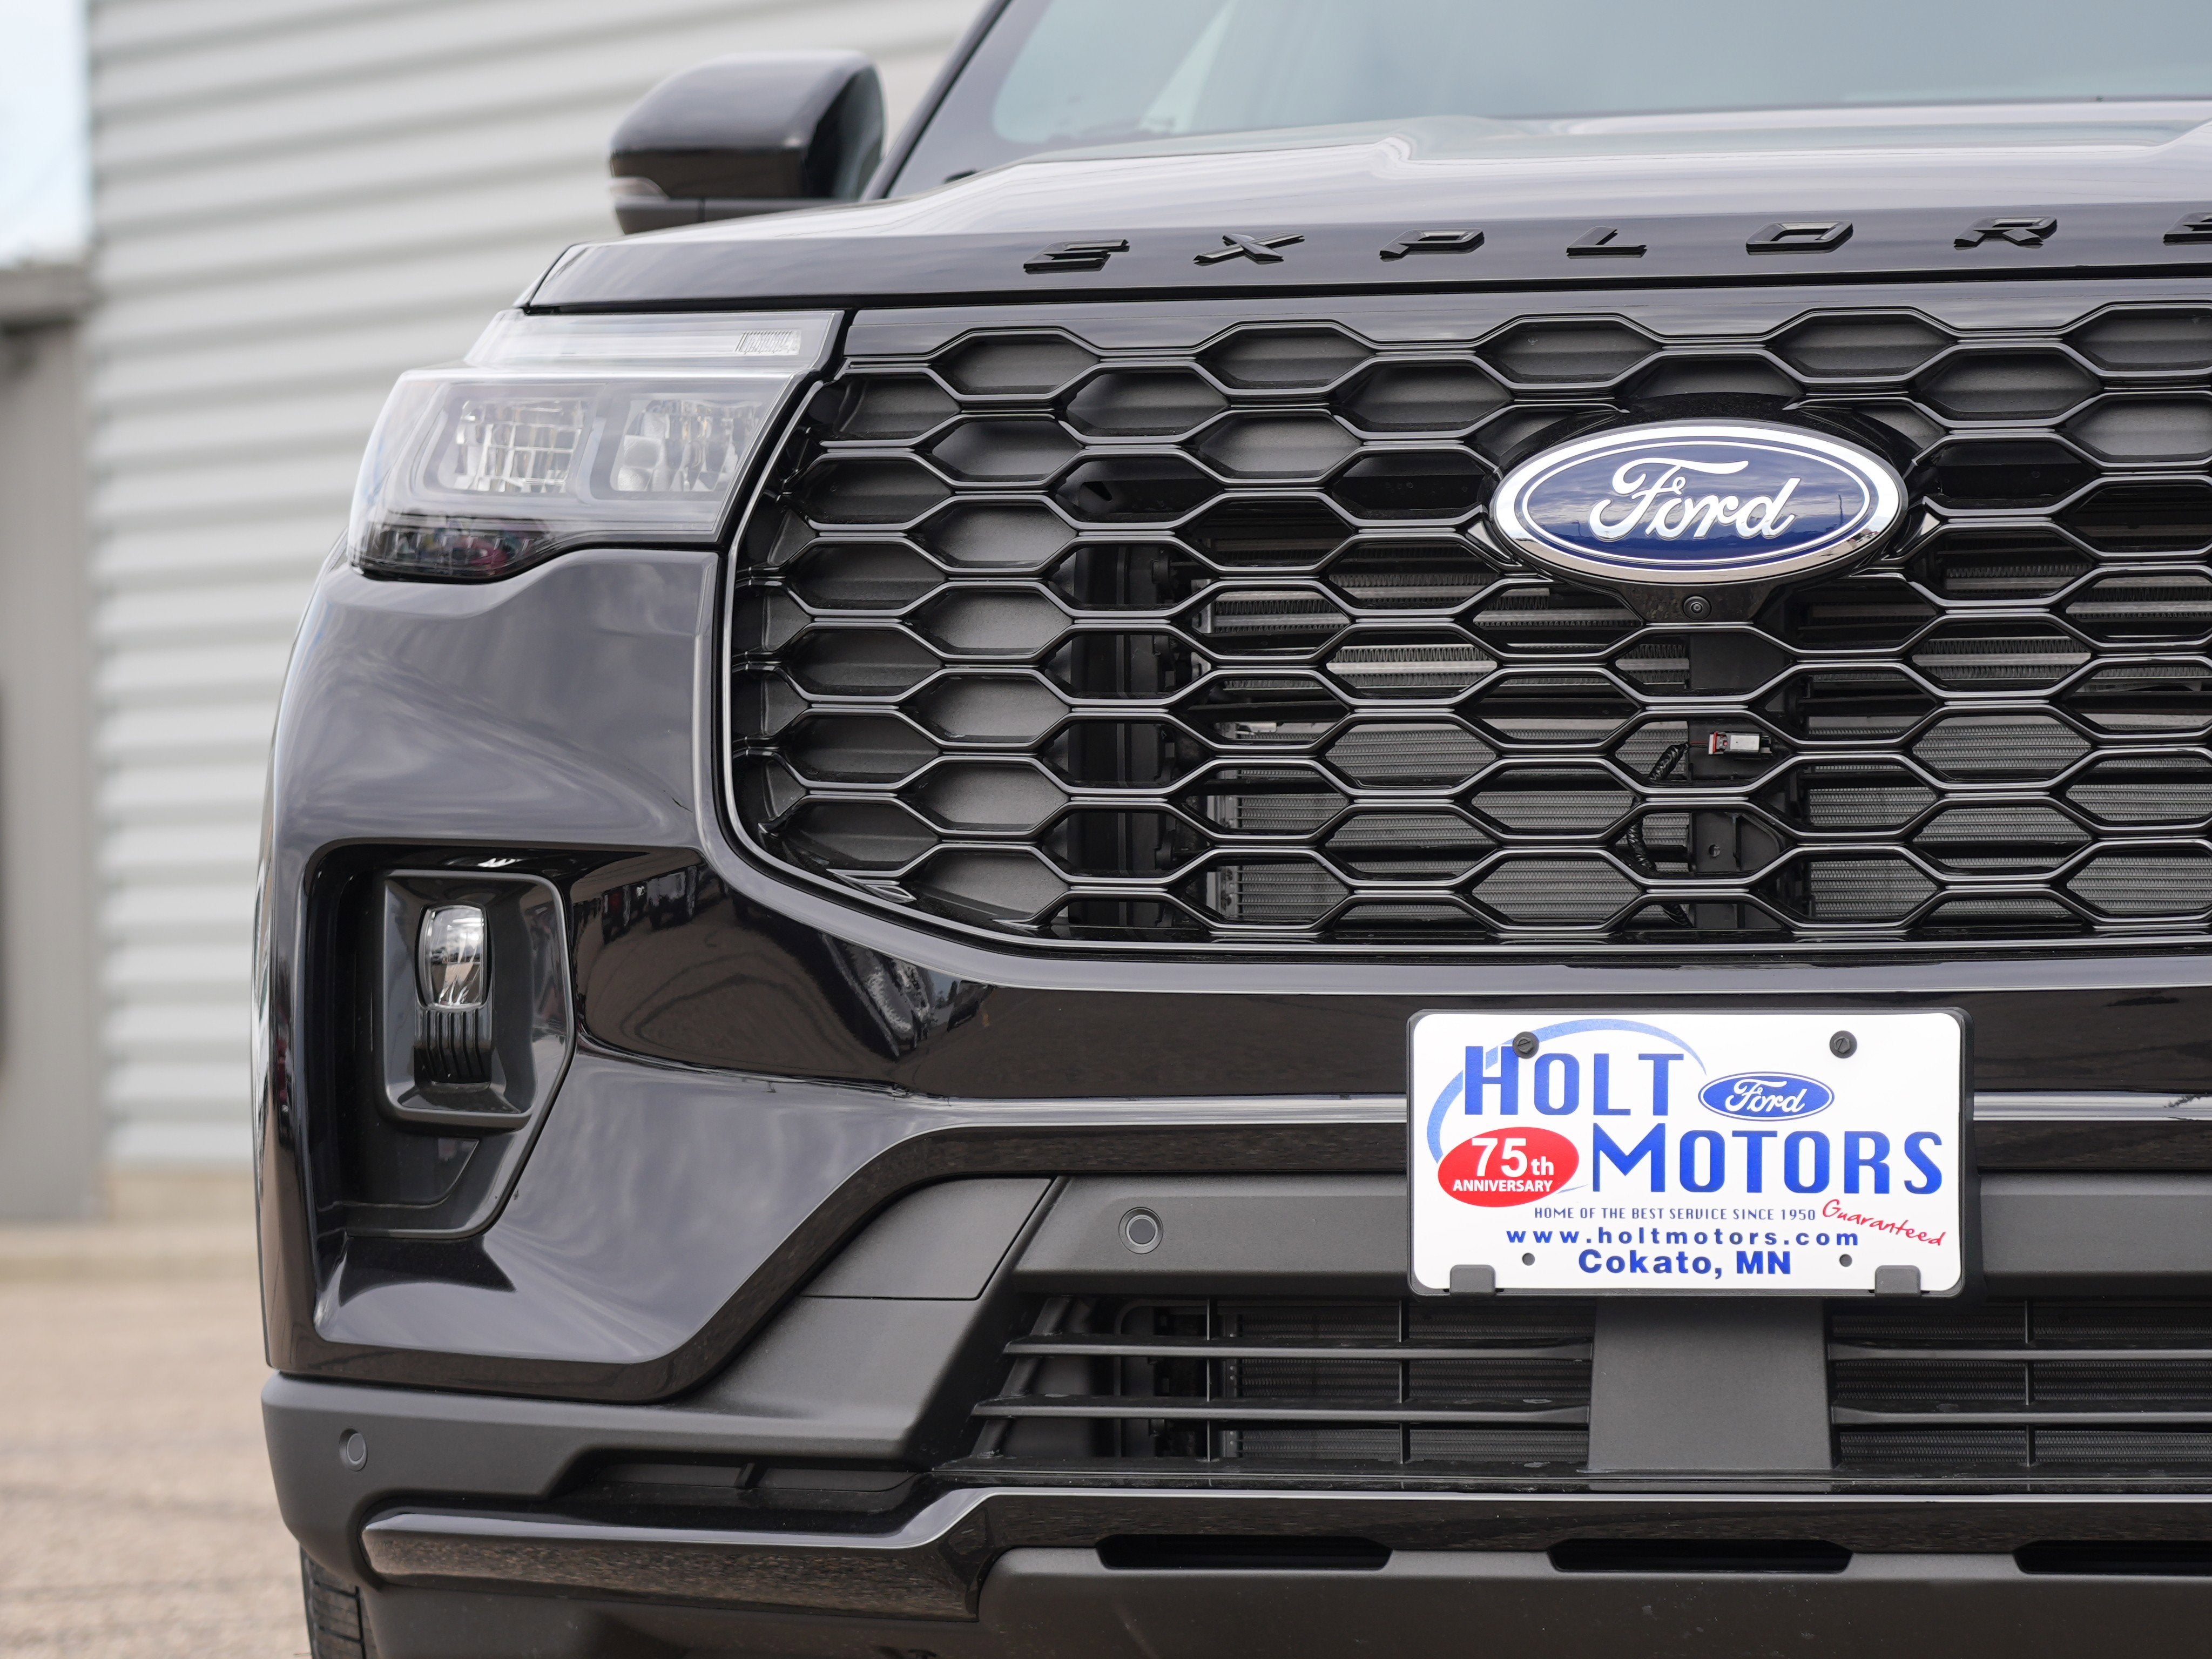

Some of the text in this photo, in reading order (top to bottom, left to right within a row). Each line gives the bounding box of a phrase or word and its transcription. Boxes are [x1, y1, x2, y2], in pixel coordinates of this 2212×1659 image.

[1588, 457, 1801, 541] Ford
[1465, 1046, 1684, 1116] HOLT
[1725, 1078, 1808, 1112] Ford
[1472, 1137, 1554, 1177] 75th
[1592, 1123, 1943, 1195] MOTORS
[1453, 1179, 1553, 1192] ANNIVERSARY
[1534, 1207, 1816, 1220] HOME OF THE BEST SERVICE SINCE 1950
[1822, 1198, 1946, 1246] Guaranteed
[1506, 1226, 1858, 1246] www.holtmotors.com
[1578, 1249, 1791, 1279] Cokato, MN
